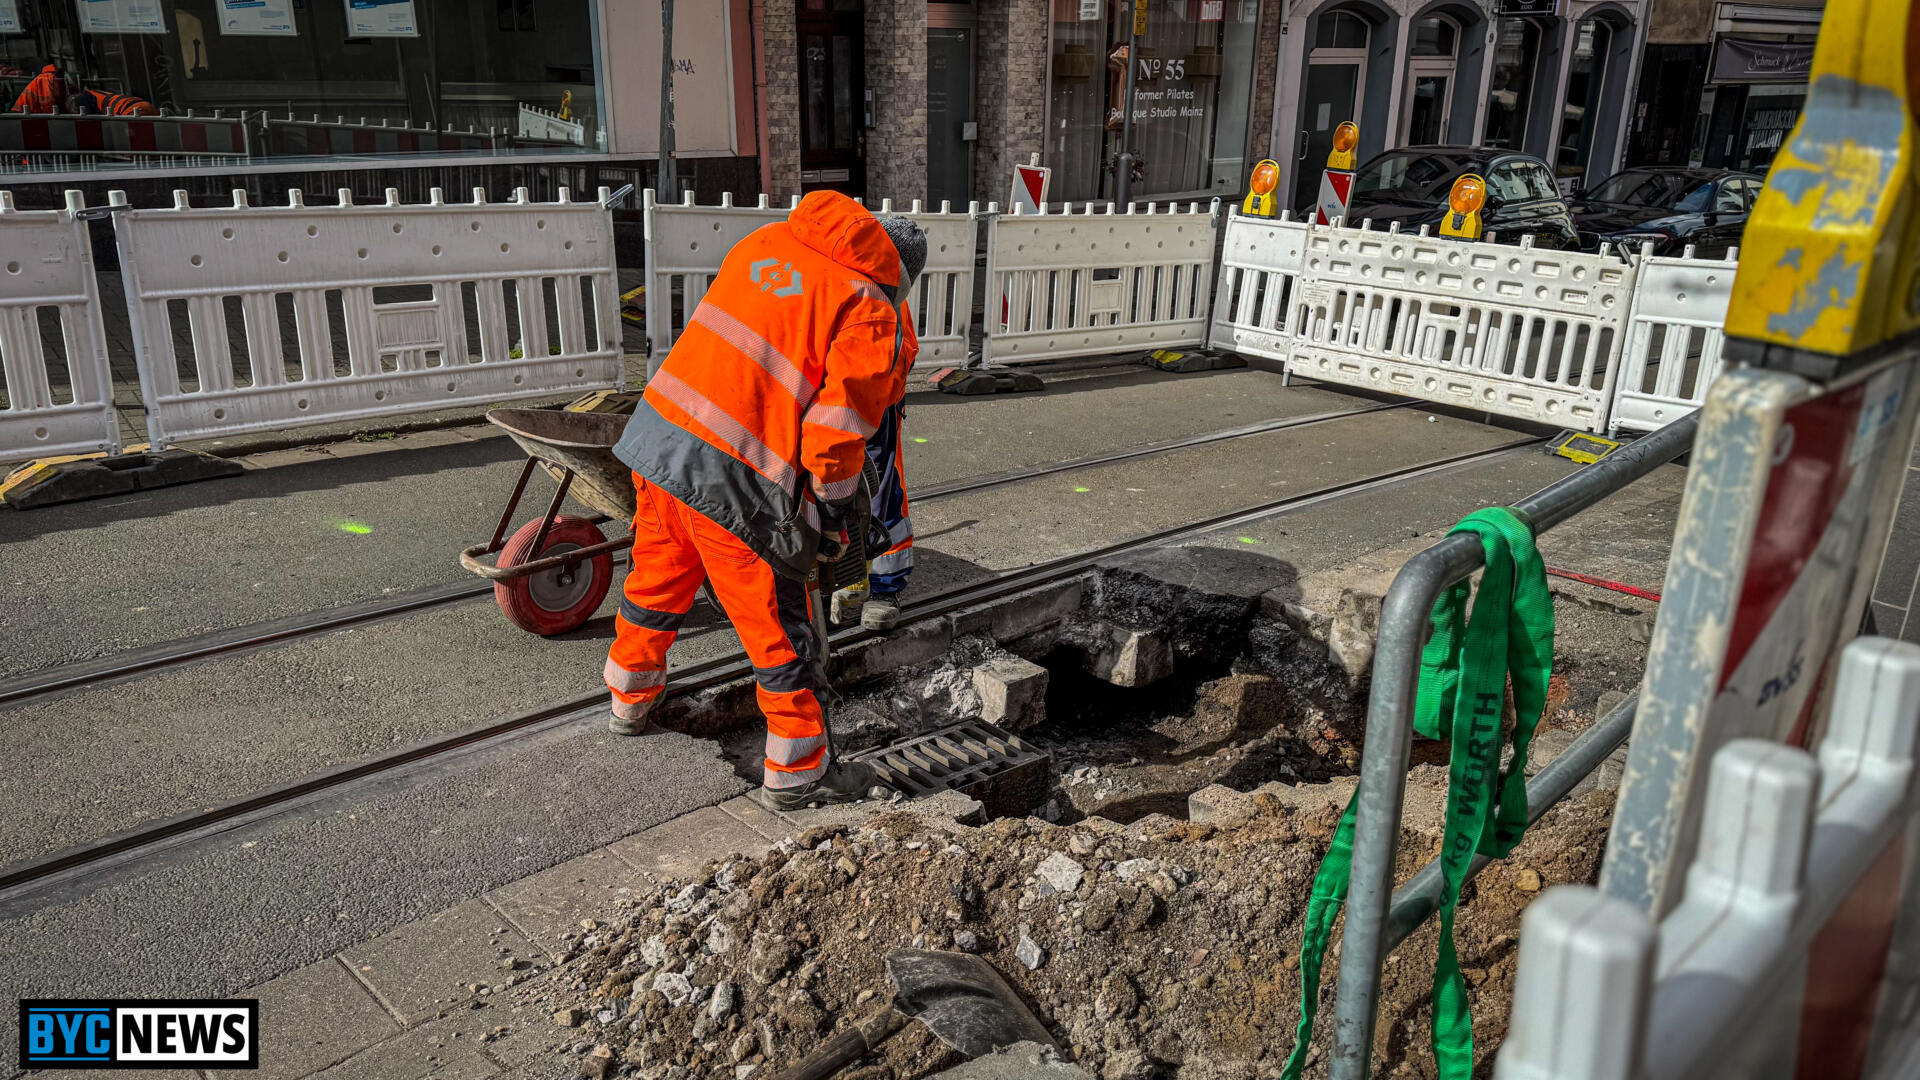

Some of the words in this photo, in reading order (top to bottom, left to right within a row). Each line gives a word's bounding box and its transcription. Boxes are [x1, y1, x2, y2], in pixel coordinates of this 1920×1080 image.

[1165, 59, 1185, 81] 55
[1124, 88, 1164, 101] former
[1166, 88, 1194, 100] Pilates
[1111, 107, 1147, 119] Bouque
[1150, 106, 1177, 117] Studio
[1179, 106, 1204, 117] Mainz
[1457, 692, 1498, 816] WÜRTH
[1444, 832, 1473, 867] kg
